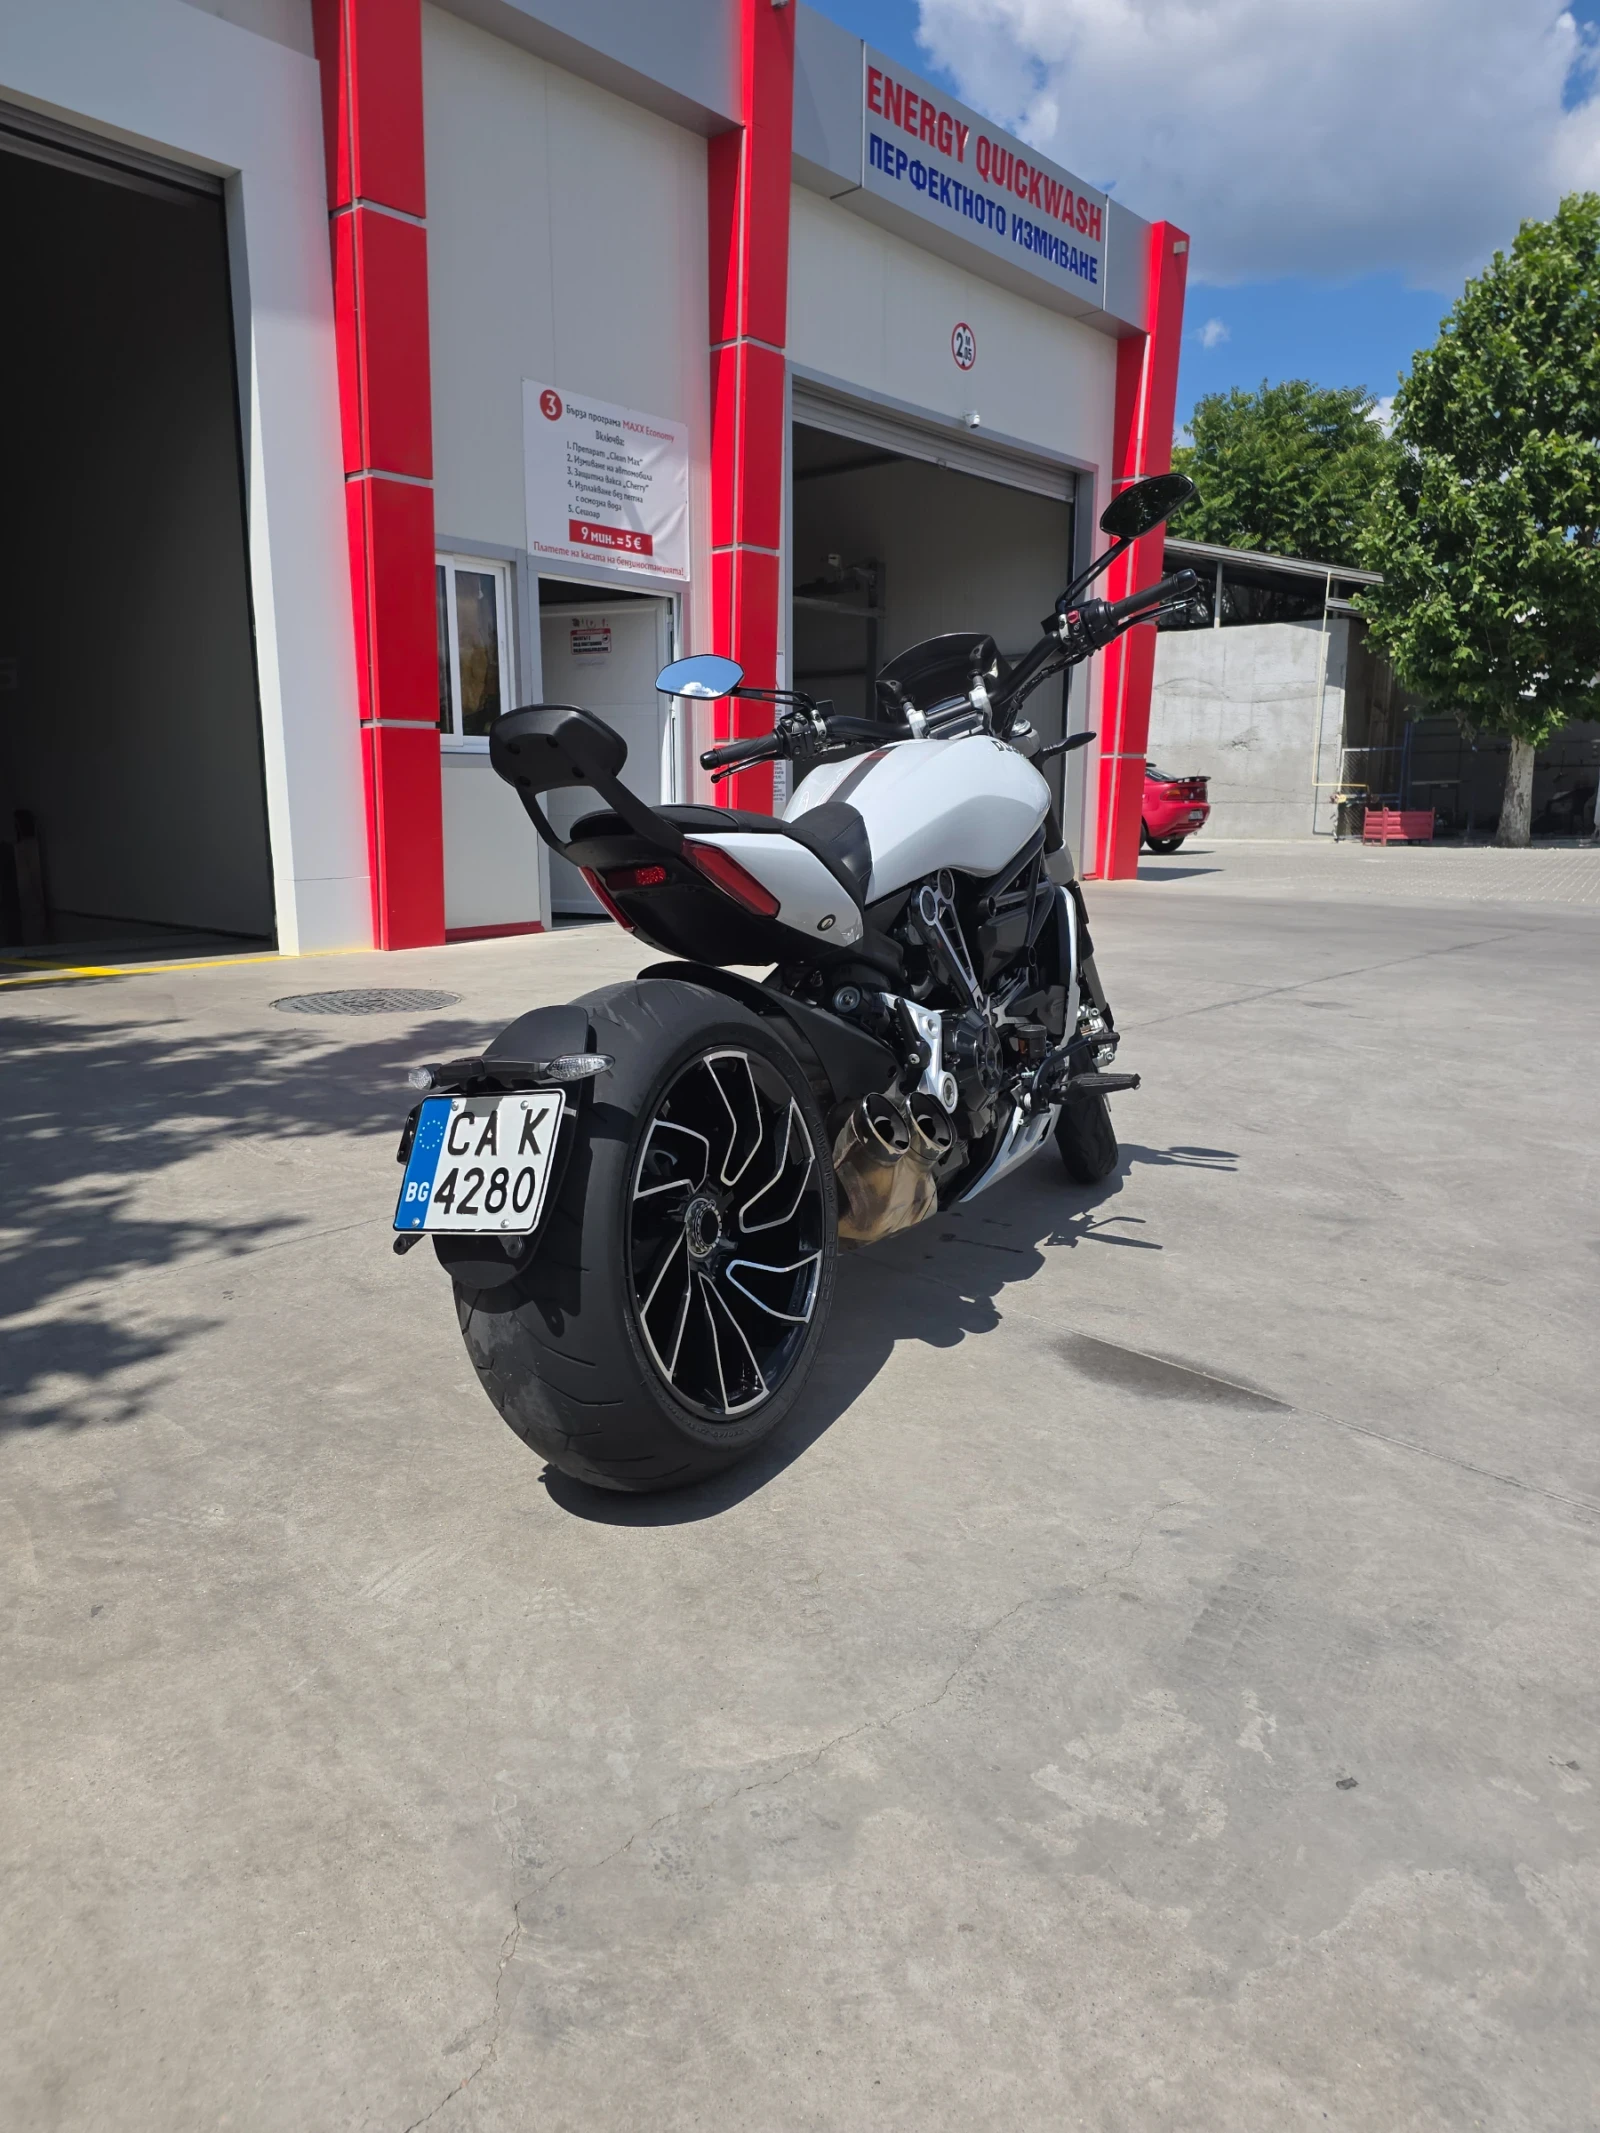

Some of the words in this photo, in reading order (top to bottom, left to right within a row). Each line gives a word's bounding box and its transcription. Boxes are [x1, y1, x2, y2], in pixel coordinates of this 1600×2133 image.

[868, 65, 969, 163] ENERGY
[976, 135, 1102, 243] QUICKWASH
[869, 132, 1007, 236] ПЕРФЕКТНОТО
[1012, 213, 1098, 284] ИЗМИВАНЕ
[956, 332, 963, 358] 2
[546, 394, 557, 416] 3
[566, 404, 587, 419] Бърза
[588, 413, 621, 427] програма
[622, 420, 645, 435] MAXX
[645, 426, 674, 443] Economy
[566, 441, 572, 450] 1.
[572, 442, 606, 457] Препарат
[595, 430, 625, 446] Включва:
[566, 453, 573, 463] 2.
[574, 455, 605, 471] Измиване
[606, 465, 614, 473] на
[614, 466, 653, 481] автомобила
[566, 466, 573, 475] 3.
[574, 468, 604, 483] Защитна
[605, 475, 622, 487] вакса
[567, 479, 574, 488] 4.
[575, 481, 612, 497] Изплакване
[612, 489, 623, 501] без
[623, 494, 643, 504] петна
[579, 496, 606, 508] осмозна
[607, 500, 622, 512] вода
[567, 504, 574, 513] 5.
[575, 506, 601, 519] Сешоар
[581, 526, 589, 540] 9
[590, 531, 615, 546] мин.
[625, 534, 632, 548] 5
[633, 536, 642, 550] €
[533, 541, 570, 556] Платете
[570, 549, 580, 558] на
[580, 549, 606, 563] касата
[607, 555, 616, 563] на
[617, 556, 684, 576] бензиностанцията!
[447, 1110, 498, 1156] CA
[517, 1107, 550, 1156] K
[405, 1181, 430, 1202] BG
[433, 1166, 536, 1216] 4280
